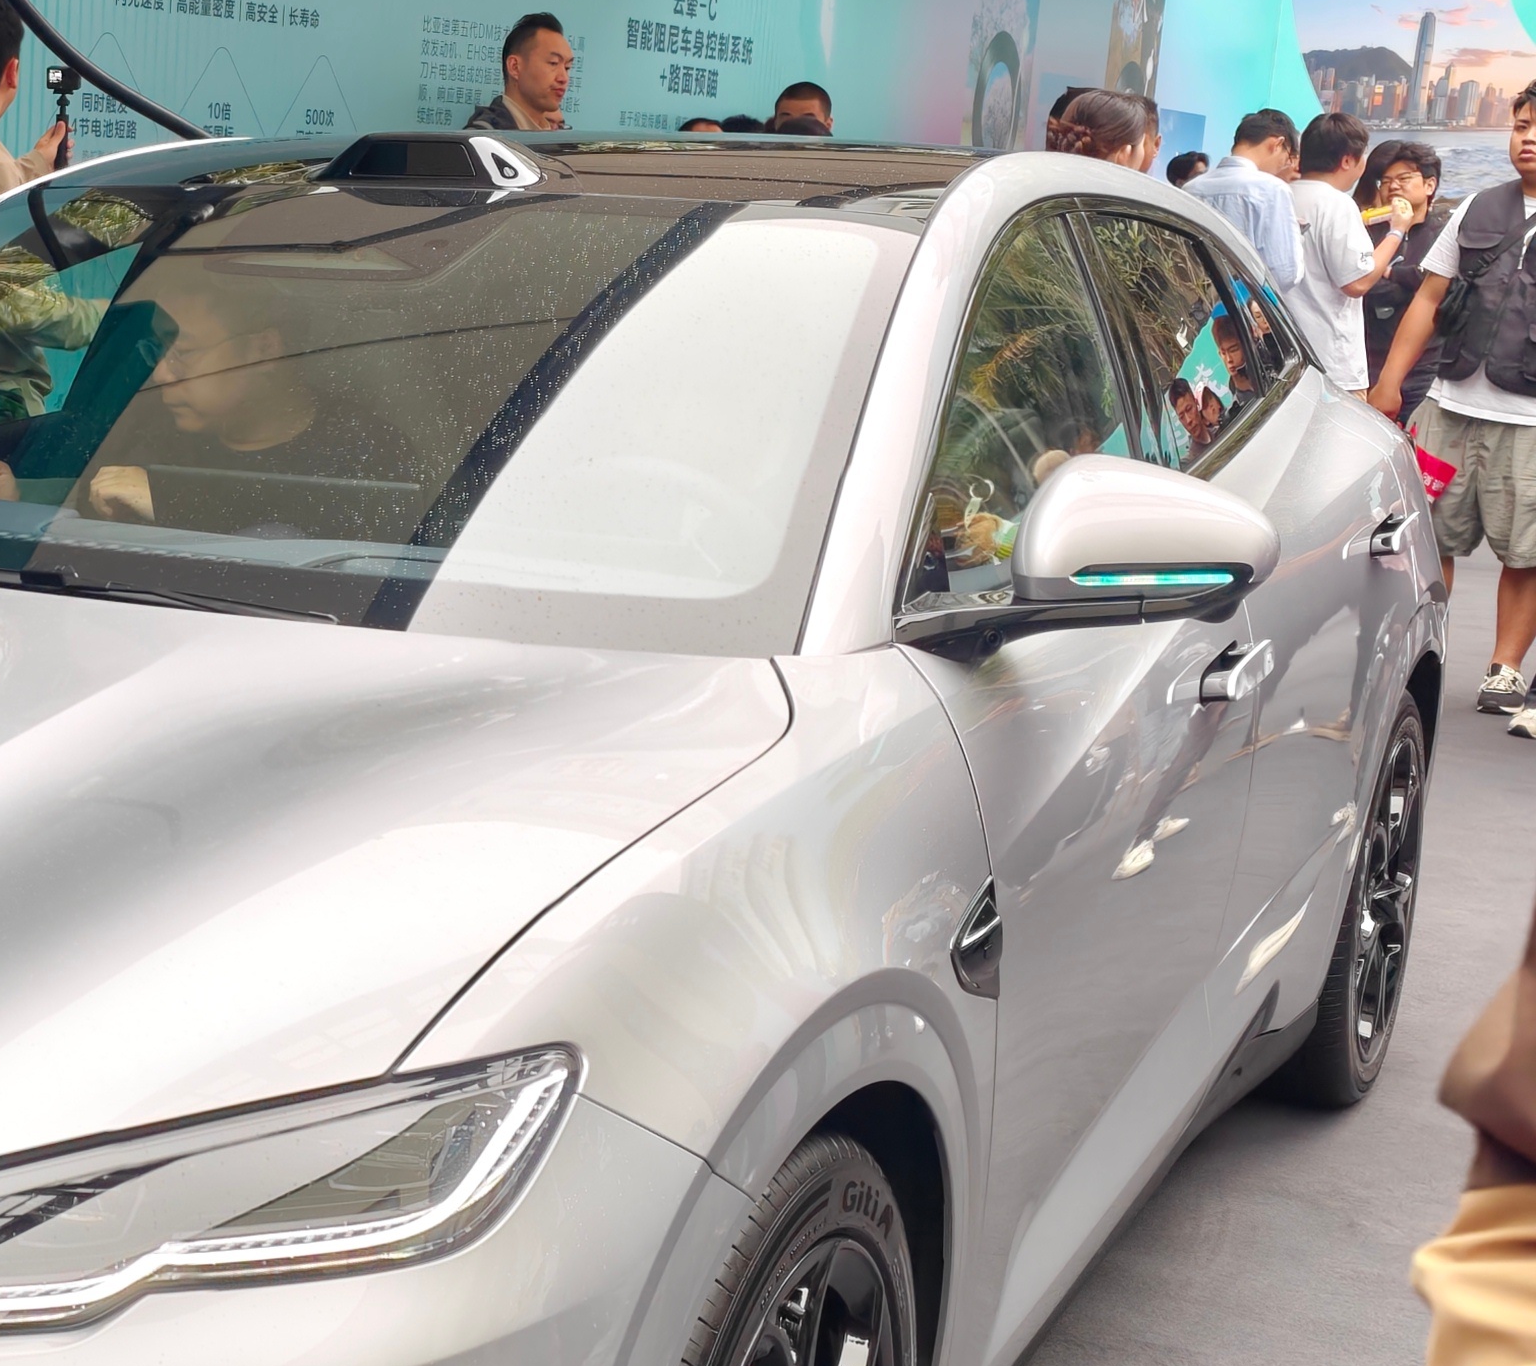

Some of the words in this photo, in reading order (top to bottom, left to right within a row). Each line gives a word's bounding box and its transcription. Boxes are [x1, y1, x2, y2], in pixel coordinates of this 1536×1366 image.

[245, 1, 279, 24] 高安全
[288, 6, 320, 29] 长寿命
[626, 17, 754, 65] 智能阻尼车身控制系统
[207, 101, 232, 121] 10倍
[305, 108, 335, 127] 500次
[71, 117, 137, 139] 4节电池短路
